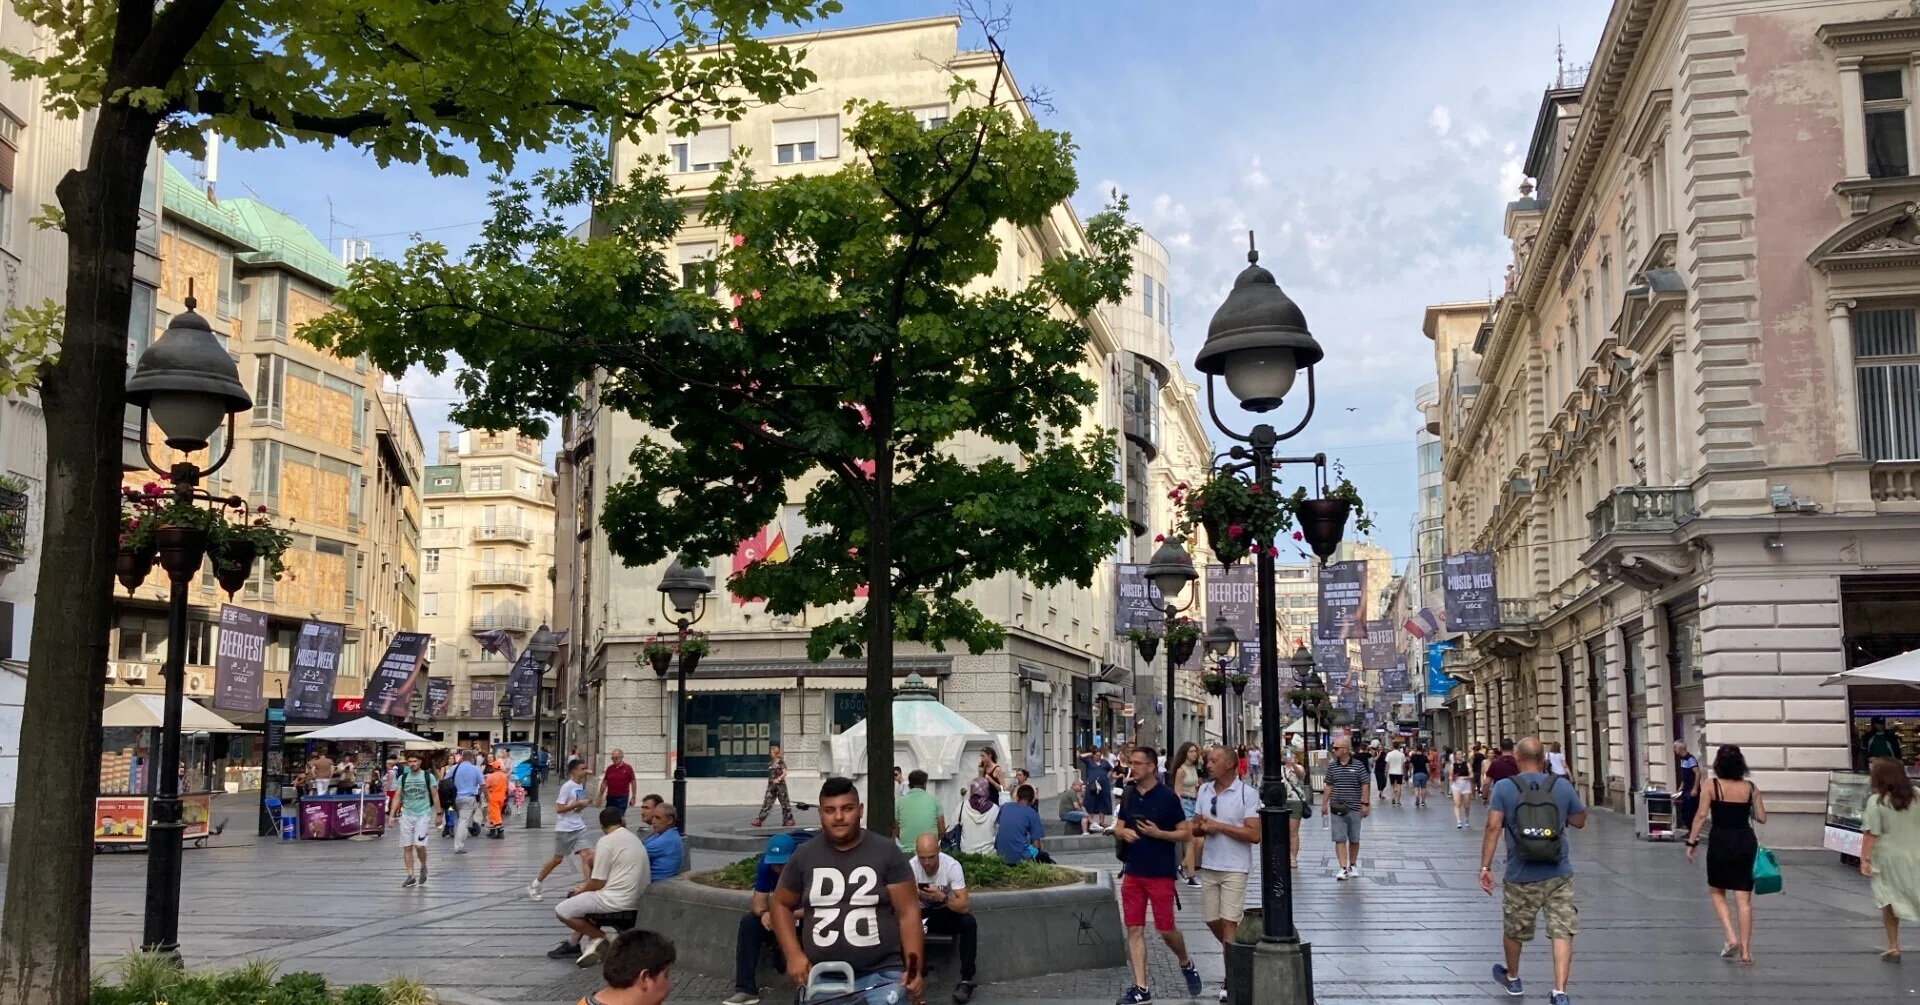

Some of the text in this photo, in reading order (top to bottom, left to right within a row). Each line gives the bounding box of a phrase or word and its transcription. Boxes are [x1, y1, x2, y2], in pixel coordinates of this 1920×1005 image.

[1120, 583, 1141, 598] MUSIC
[1448, 573, 1493, 590] MUSIC WEEK
[1208, 582, 1254, 603] BEER FEST
[219, 629, 265, 663] BEER FEST
[809, 866, 880, 907] D2
